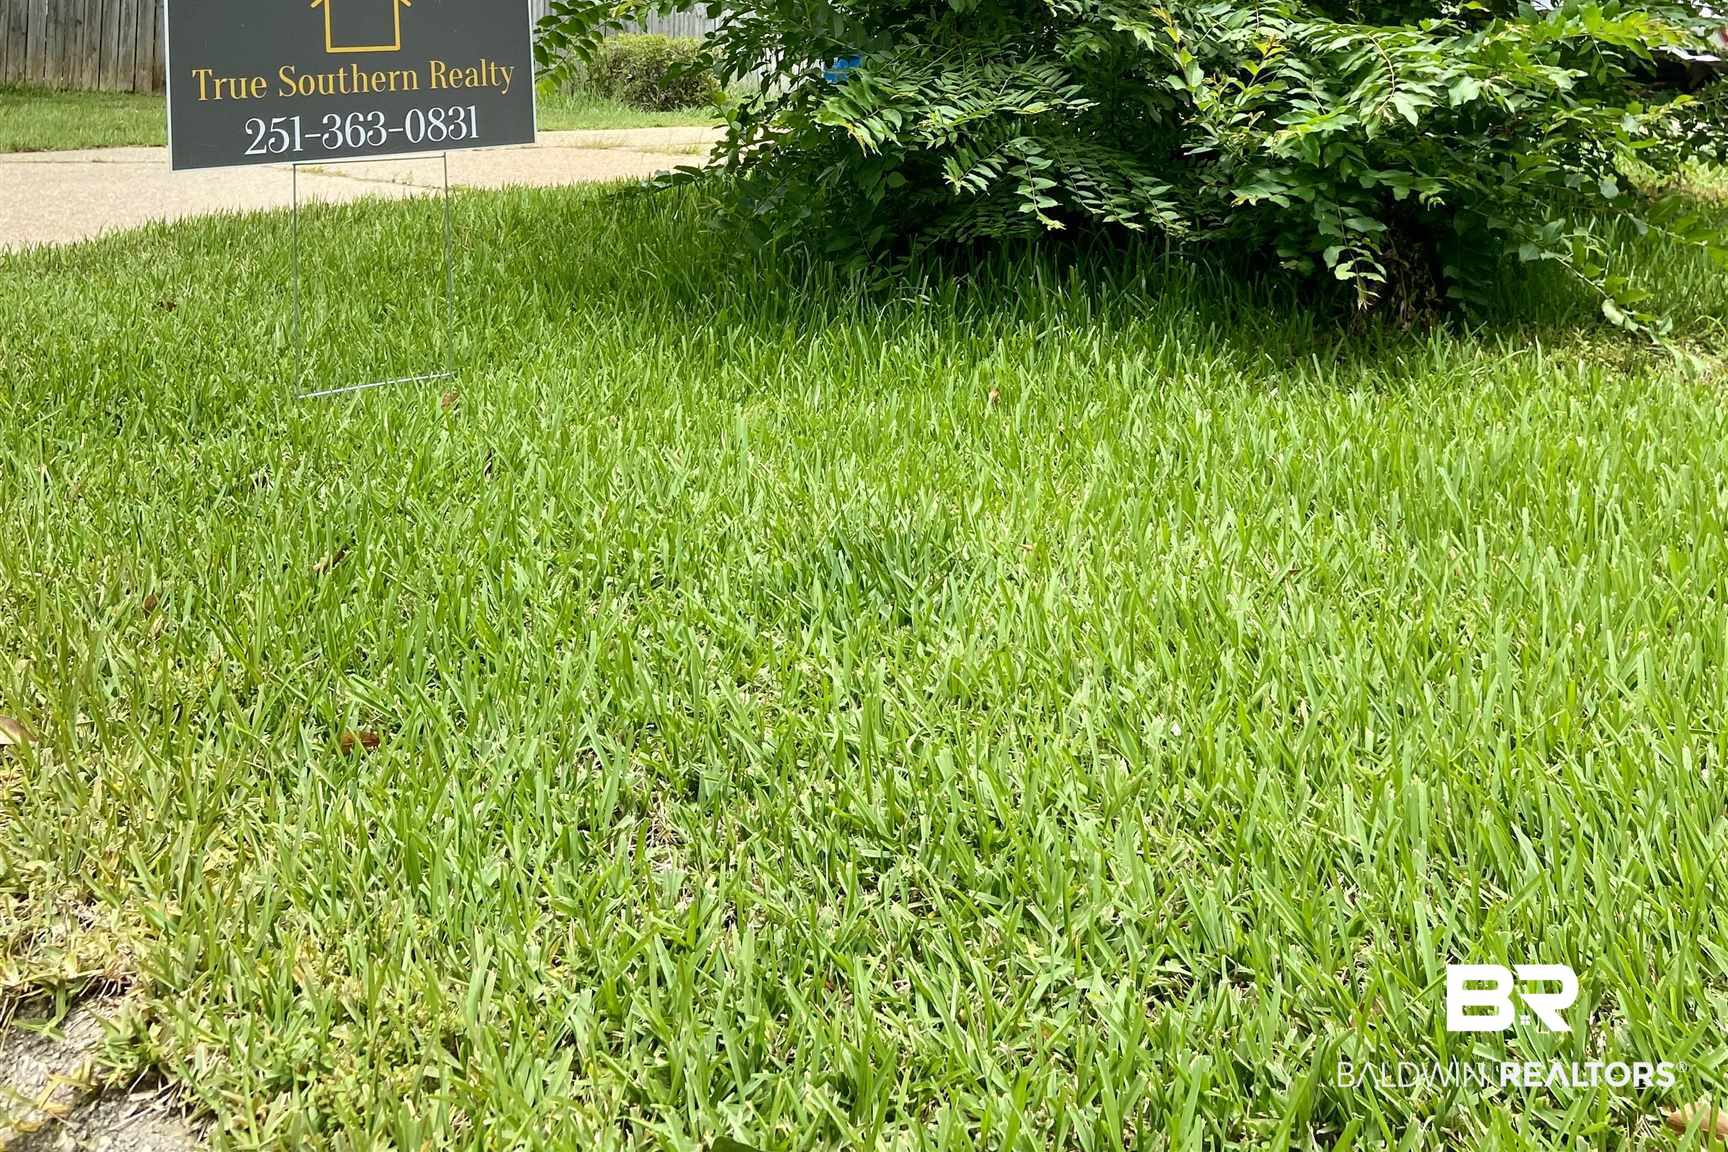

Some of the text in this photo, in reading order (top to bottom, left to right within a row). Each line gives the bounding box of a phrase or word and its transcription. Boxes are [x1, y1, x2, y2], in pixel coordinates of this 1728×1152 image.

[191, 58, 515, 101] True Southern Realty
[243, 105, 479, 156] 251-363-0831
